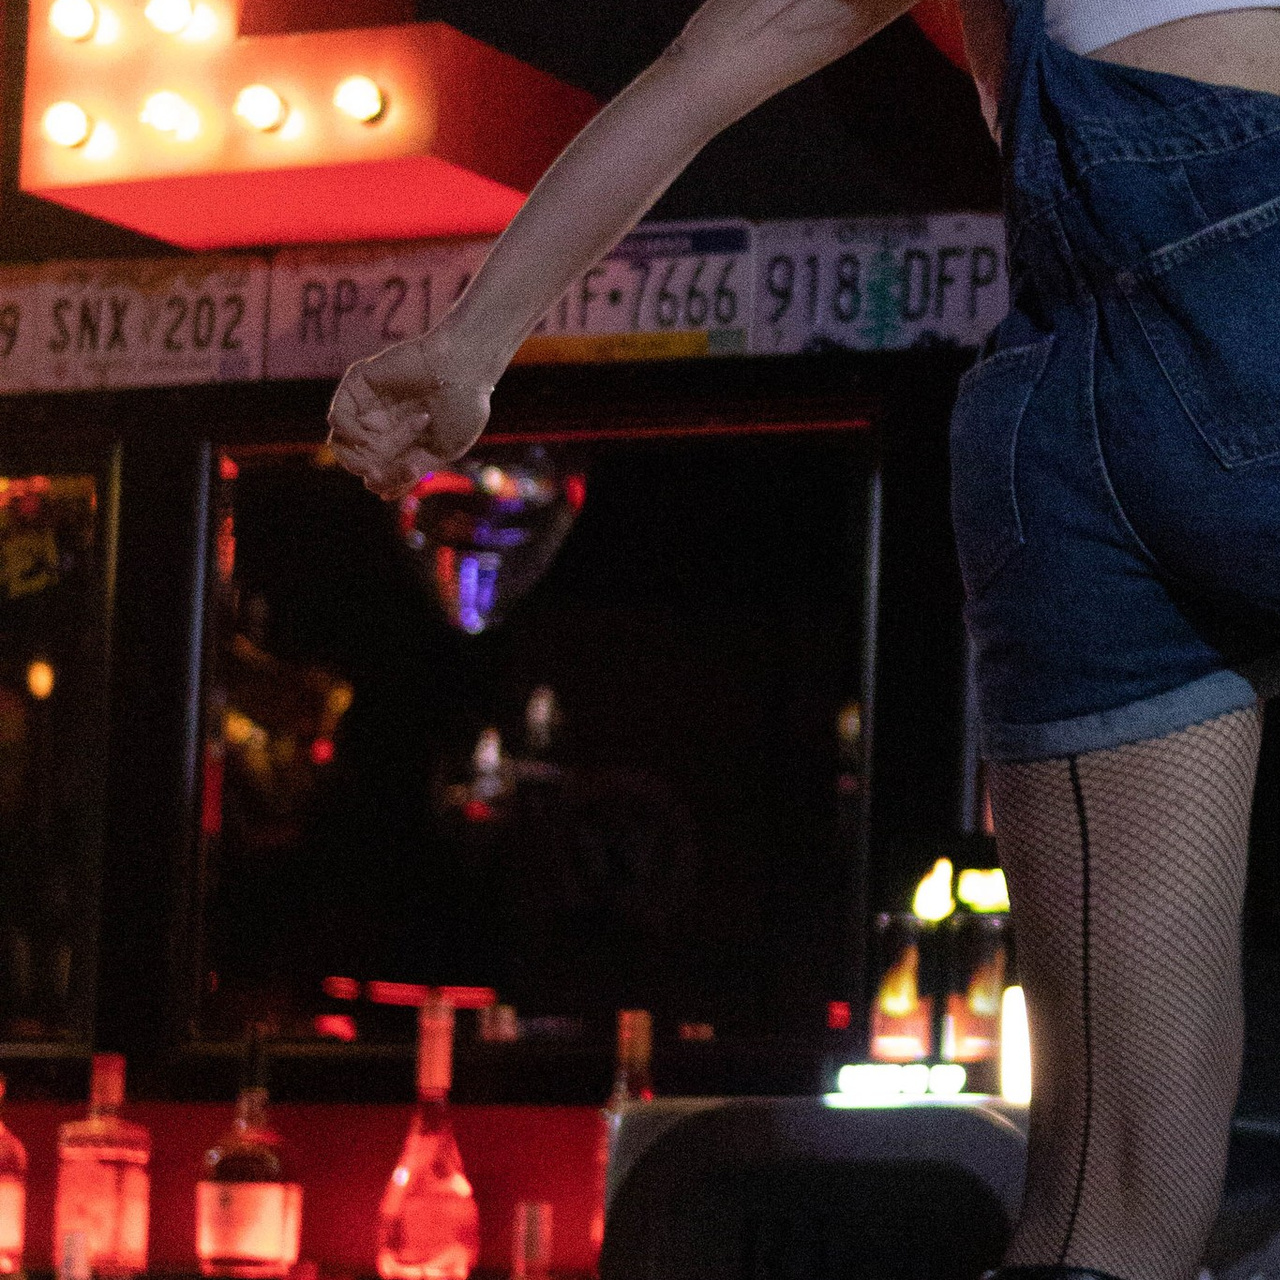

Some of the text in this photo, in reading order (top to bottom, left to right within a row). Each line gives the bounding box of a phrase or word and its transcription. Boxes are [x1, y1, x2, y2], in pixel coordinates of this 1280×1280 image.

[766, 246, 998, 324] 918 DFP
[49, 294, 246, 354] SNX 202
